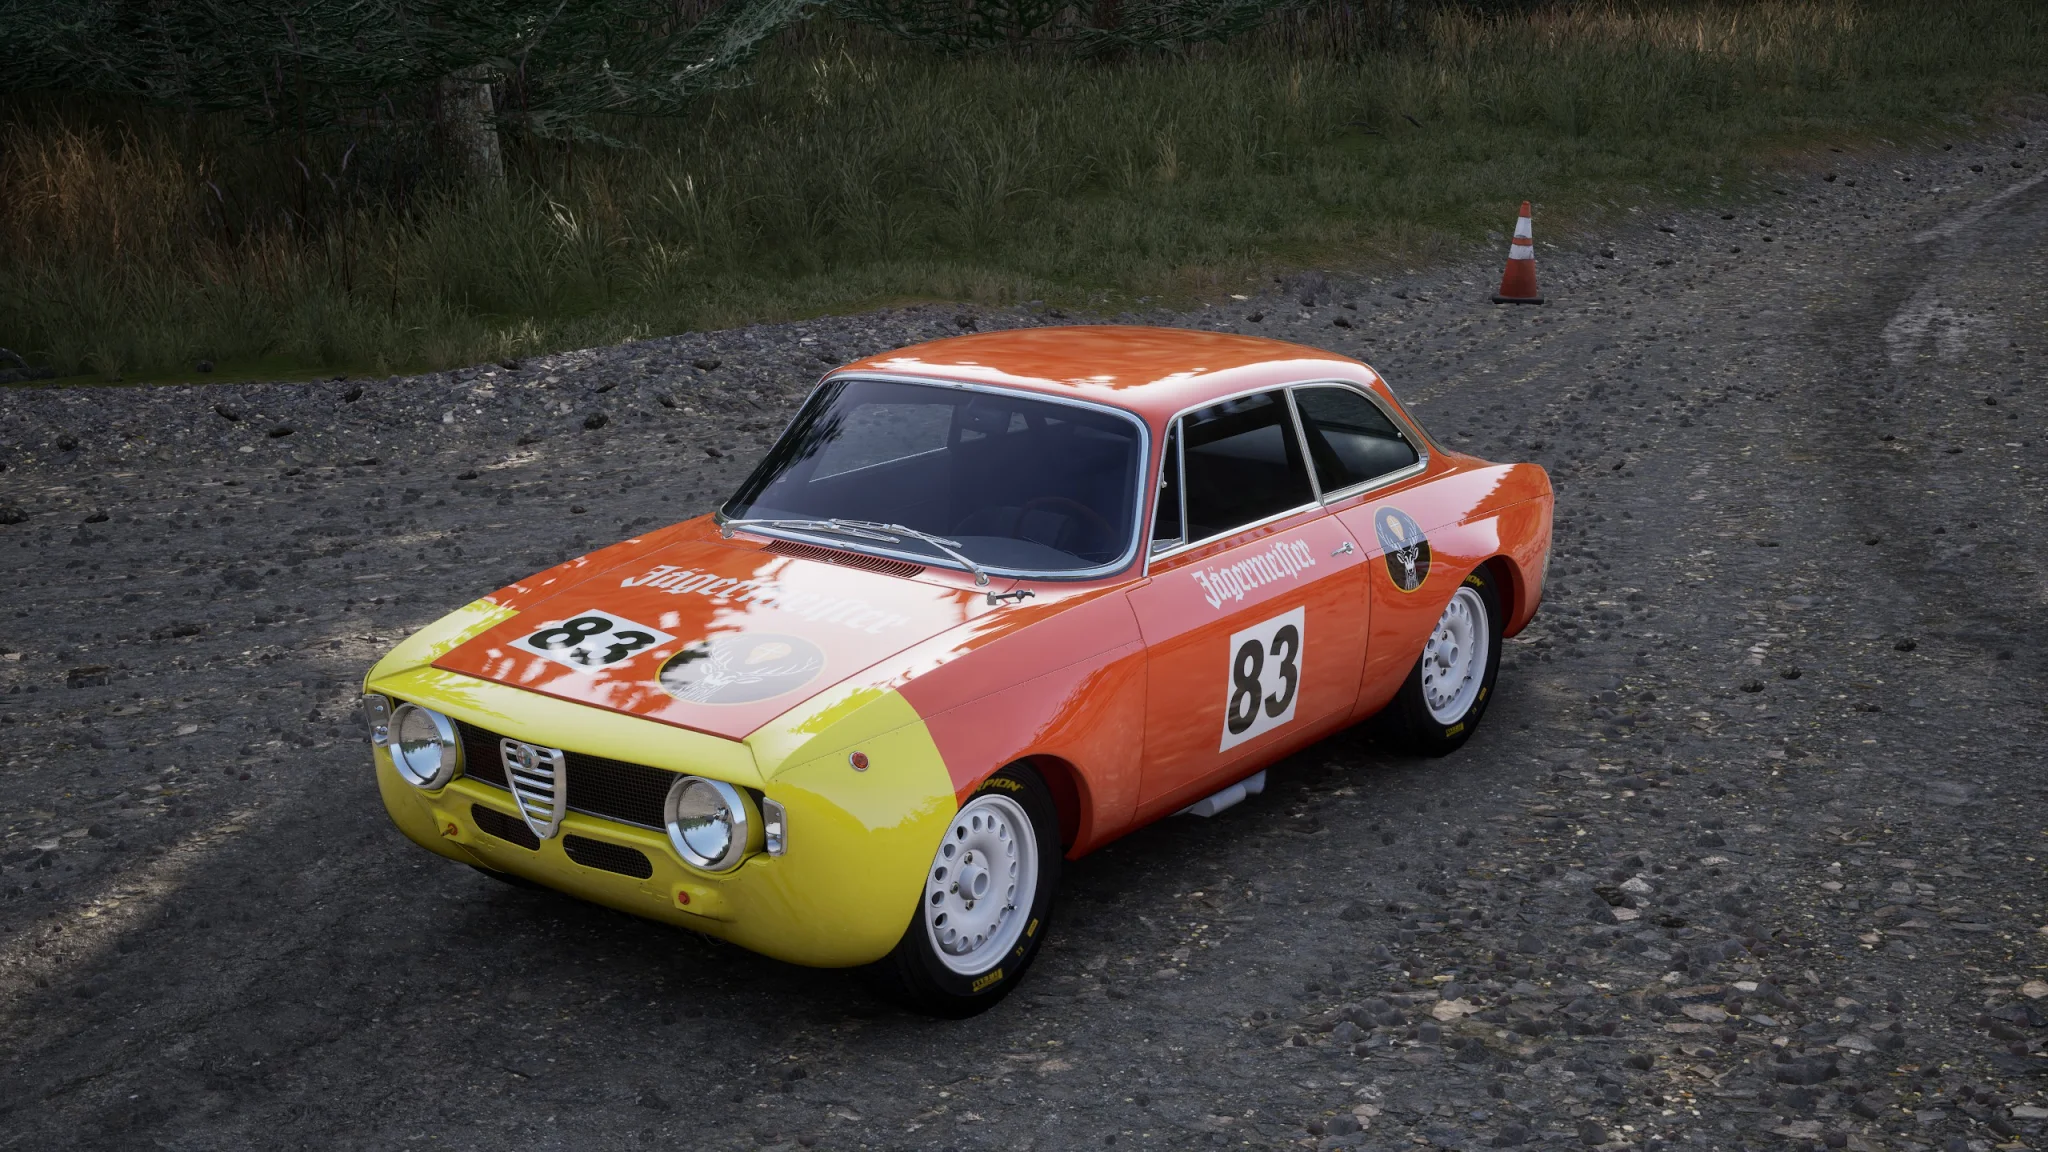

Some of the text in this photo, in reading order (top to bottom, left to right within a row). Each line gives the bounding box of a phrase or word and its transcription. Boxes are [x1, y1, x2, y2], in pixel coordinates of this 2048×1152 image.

[1191, 538, 1316, 610] Jägermeister
[528, 616, 656, 666] 83
[1227, 624, 1299, 735] 83
